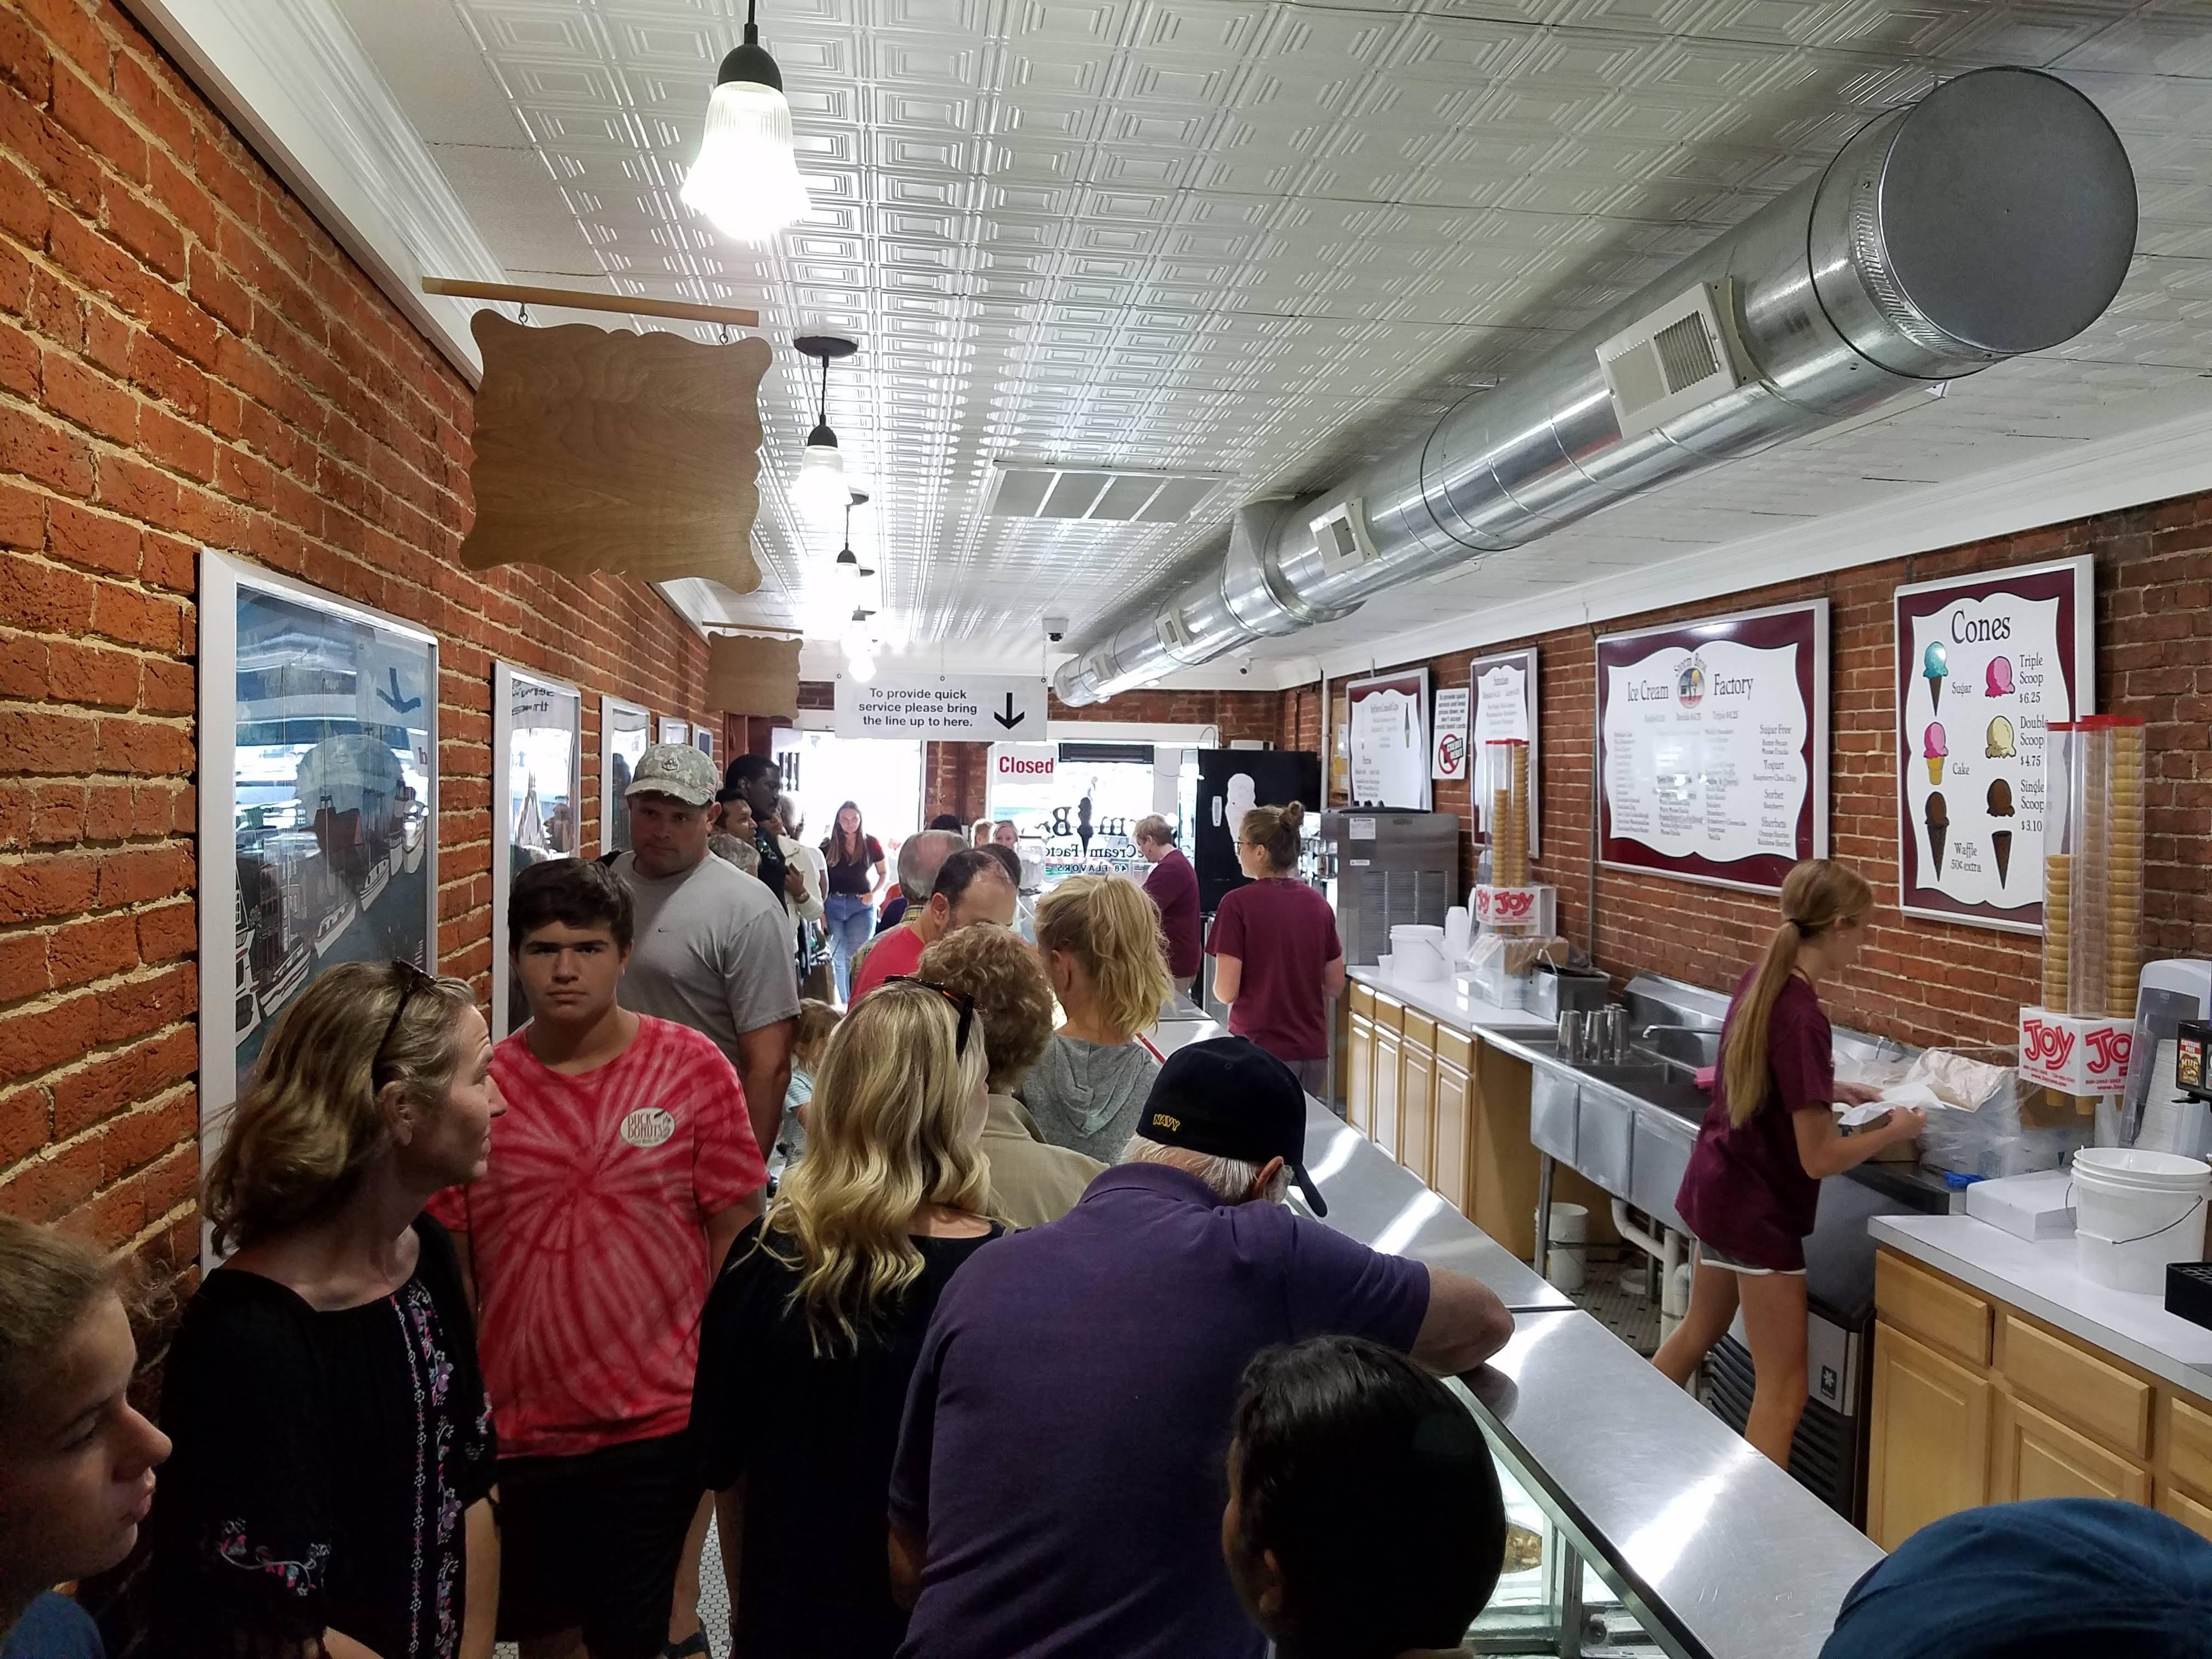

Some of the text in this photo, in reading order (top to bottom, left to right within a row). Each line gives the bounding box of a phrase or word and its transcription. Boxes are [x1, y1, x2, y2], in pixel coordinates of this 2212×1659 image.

[1951, 608, 2011, 644] Cones
[2019, 652, 2043, 670] Triple
[2019, 672, 2044, 686] Scoop
[870, 687, 967, 701] To provide quick
[1628, 680, 1669, 702] Ice Cream
[1714, 673, 1753, 701] Factory
[1952, 682, 1972, 697] Sugar
[2019, 691, 2041, 704] $6.25
[859, 702, 977, 715] service please bring
[863, 715, 973, 728] the line up to here.
[2020, 733, 2044, 749] Scoop
[999, 755, 1054, 774] Closed
[1953, 762, 1970, 775] Cake
[2020, 755, 2041, 767] $4.75
[2021, 778, 2045, 796] Single
[2021, 796, 2044, 813] Scoop
[2022, 820, 2042, 832] $3.10
[1954, 842, 1978, 859] Waffle
[1963, 862, 1982, 872] extra
[2085, 1027, 2132, 1076] JO
[2181, 1058, 2199, 1072] MUG
[628, 1113, 652, 1126] DUCK
[1153, 1114, 1181, 1132] NAVY
